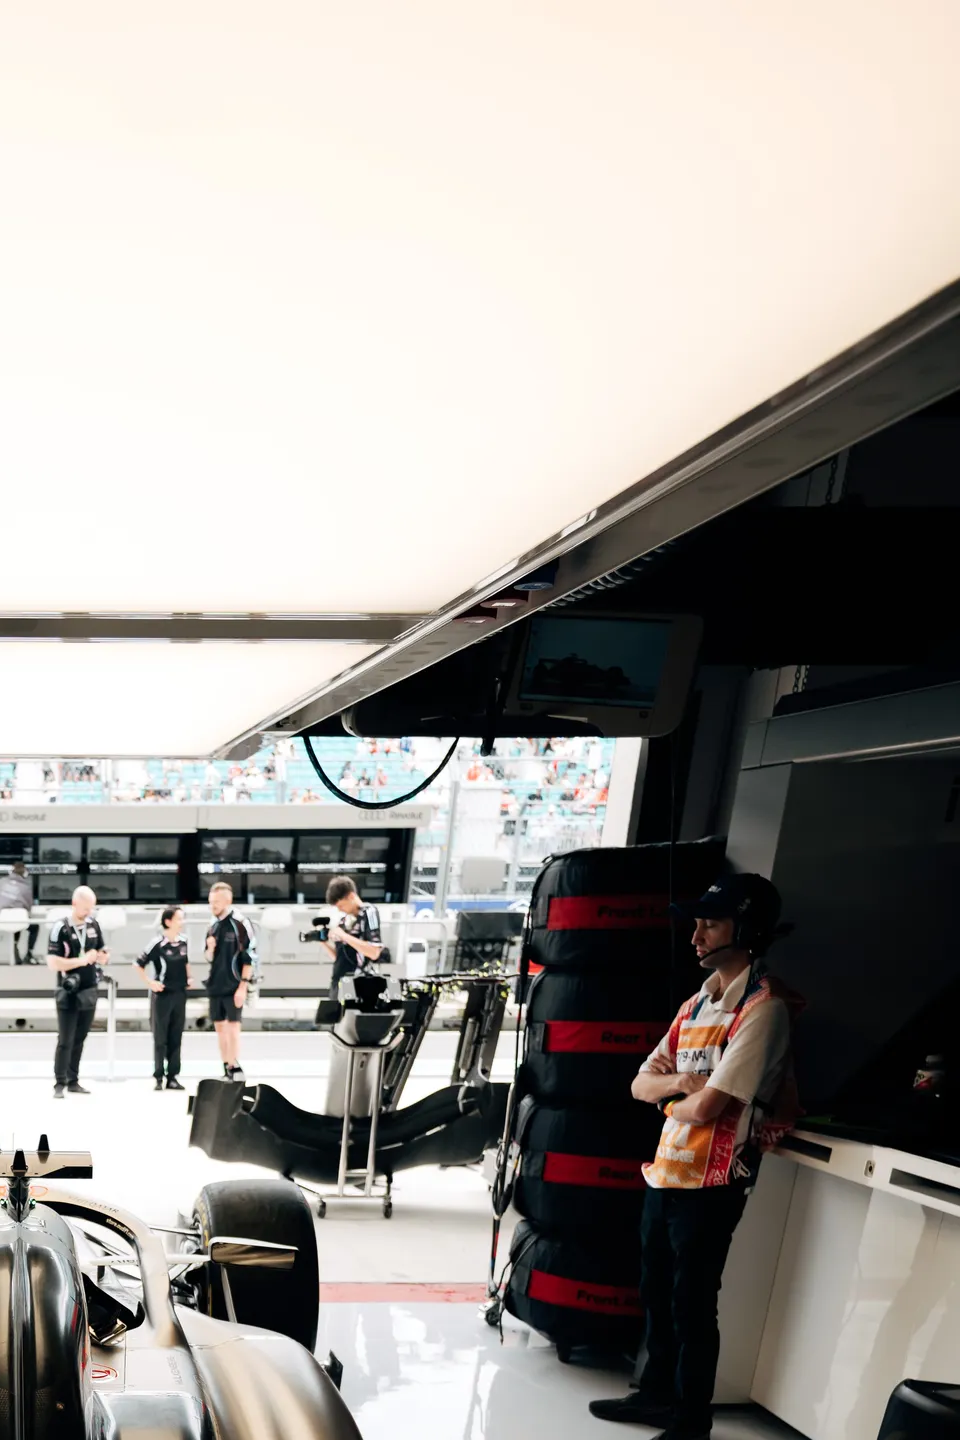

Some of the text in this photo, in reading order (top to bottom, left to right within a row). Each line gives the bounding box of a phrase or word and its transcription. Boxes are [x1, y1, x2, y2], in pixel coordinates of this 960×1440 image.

[12, 810, 47, 822] Revolut
[601, 1030, 641, 1044] Rear
[576, 1289, 620, 1306] Front
